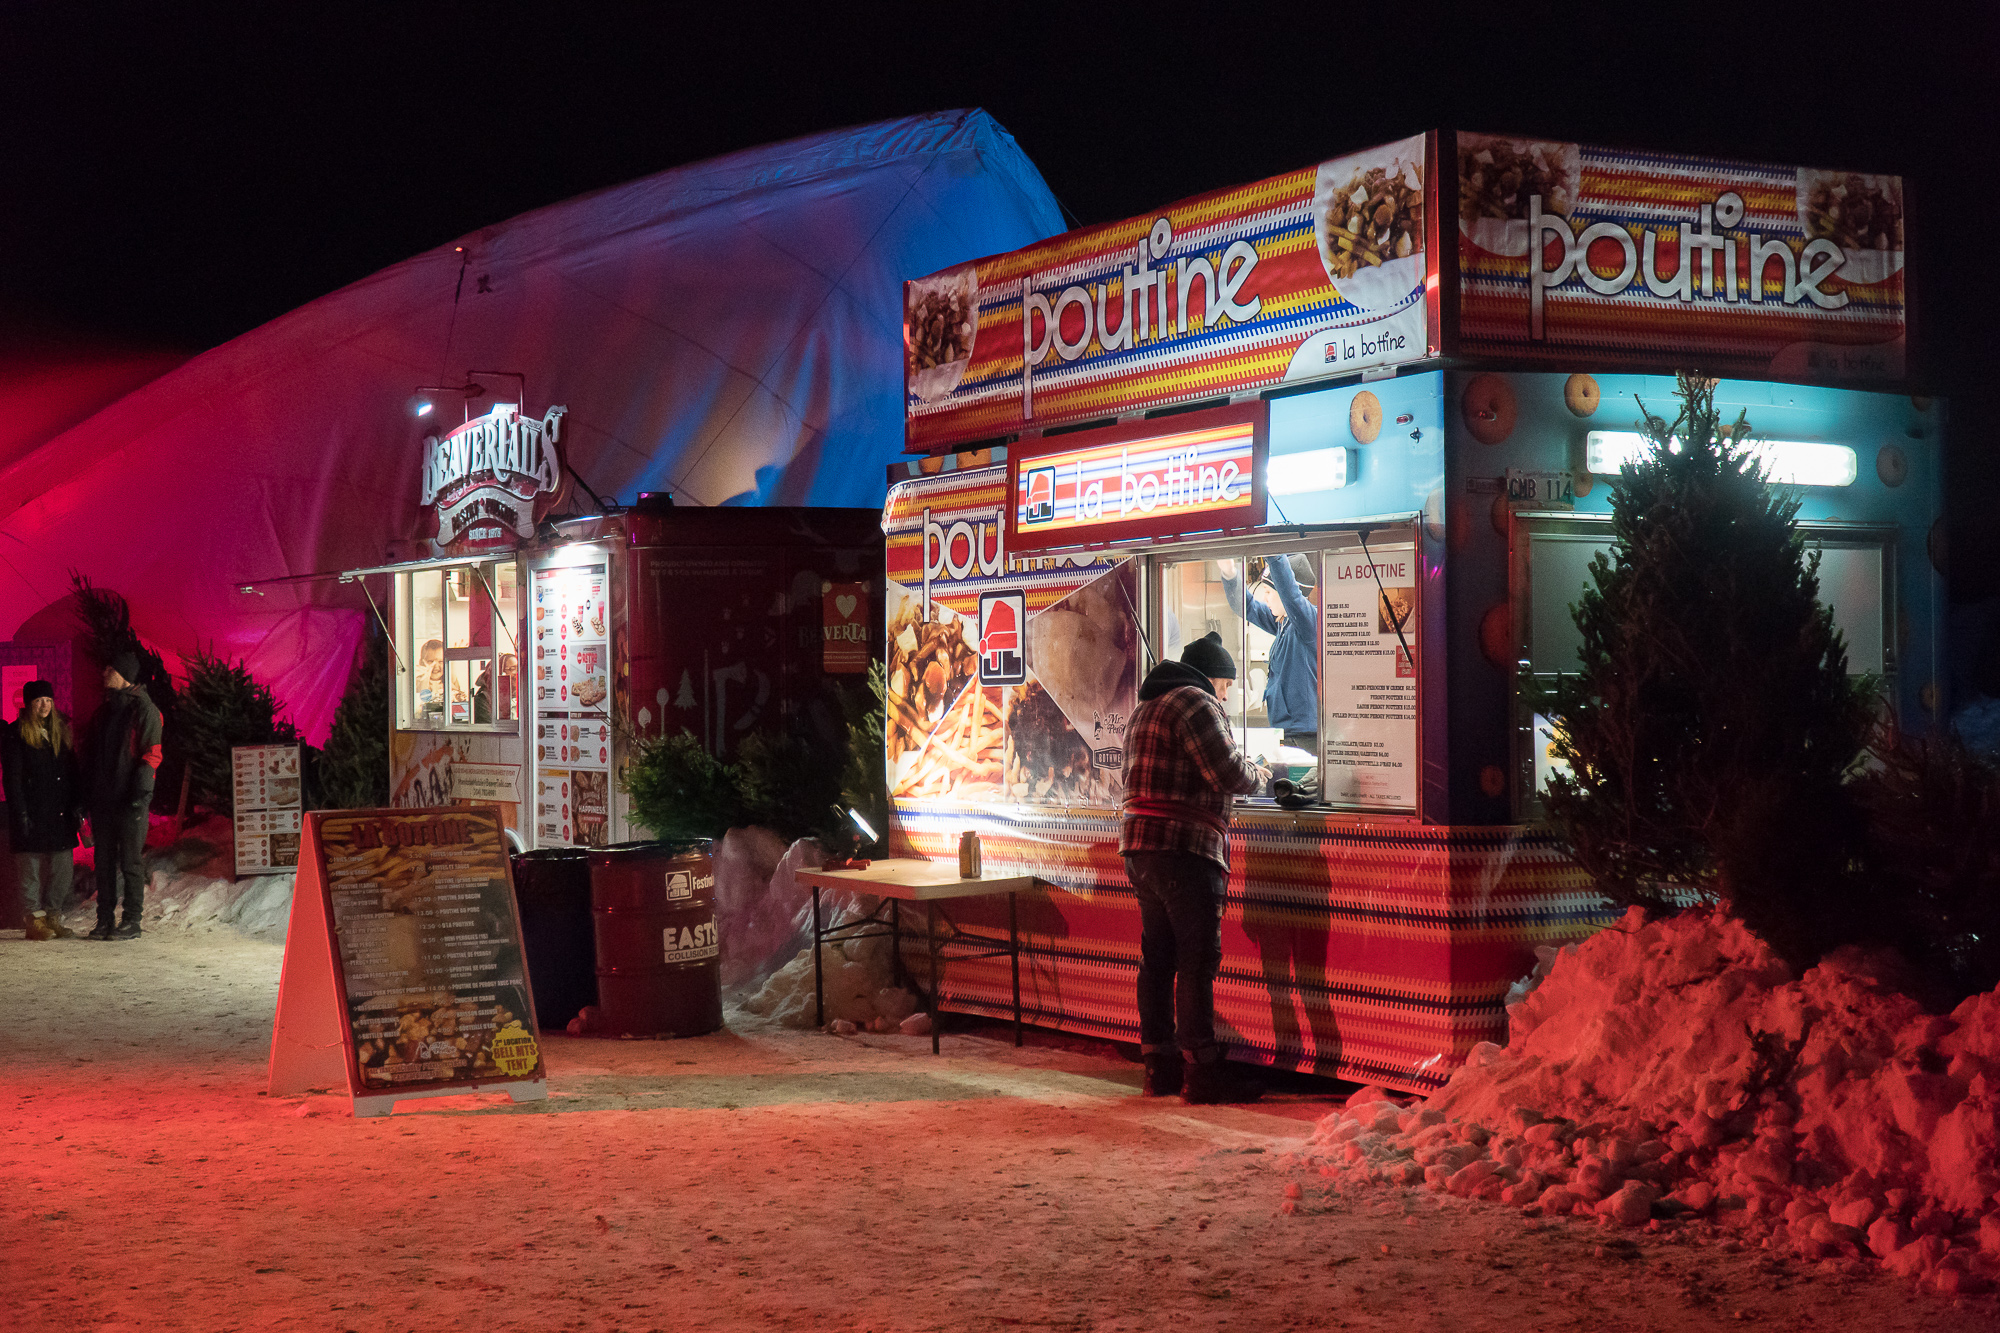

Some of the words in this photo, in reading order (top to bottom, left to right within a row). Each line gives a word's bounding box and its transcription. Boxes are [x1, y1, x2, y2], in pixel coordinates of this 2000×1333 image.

[1529, 191, 1849, 341] poutine
[1022, 216, 1262, 420] poutine
[1343, 339, 1355, 361] la
[1360, 331, 1405, 358] bottine
[420, 404, 566, 506] BEAVERTAILS
[1075, 460, 1103, 522] la
[1119, 445, 1240, 519] bottine
[1547, 479, 1571, 501] 114
[468, 528, 487, 541] SINCE
[1338, 565, 1353, 580] LA
[1355, 563, 1406, 579] BOTTINE
[668, 949, 709, 961] COLLISION
[493, 1046, 515, 1059] BELL
[516, 1043, 536, 1057] MTS
[503, 1037, 532, 1046] LOCATION
[505, 1058, 528, 1071] TENT
